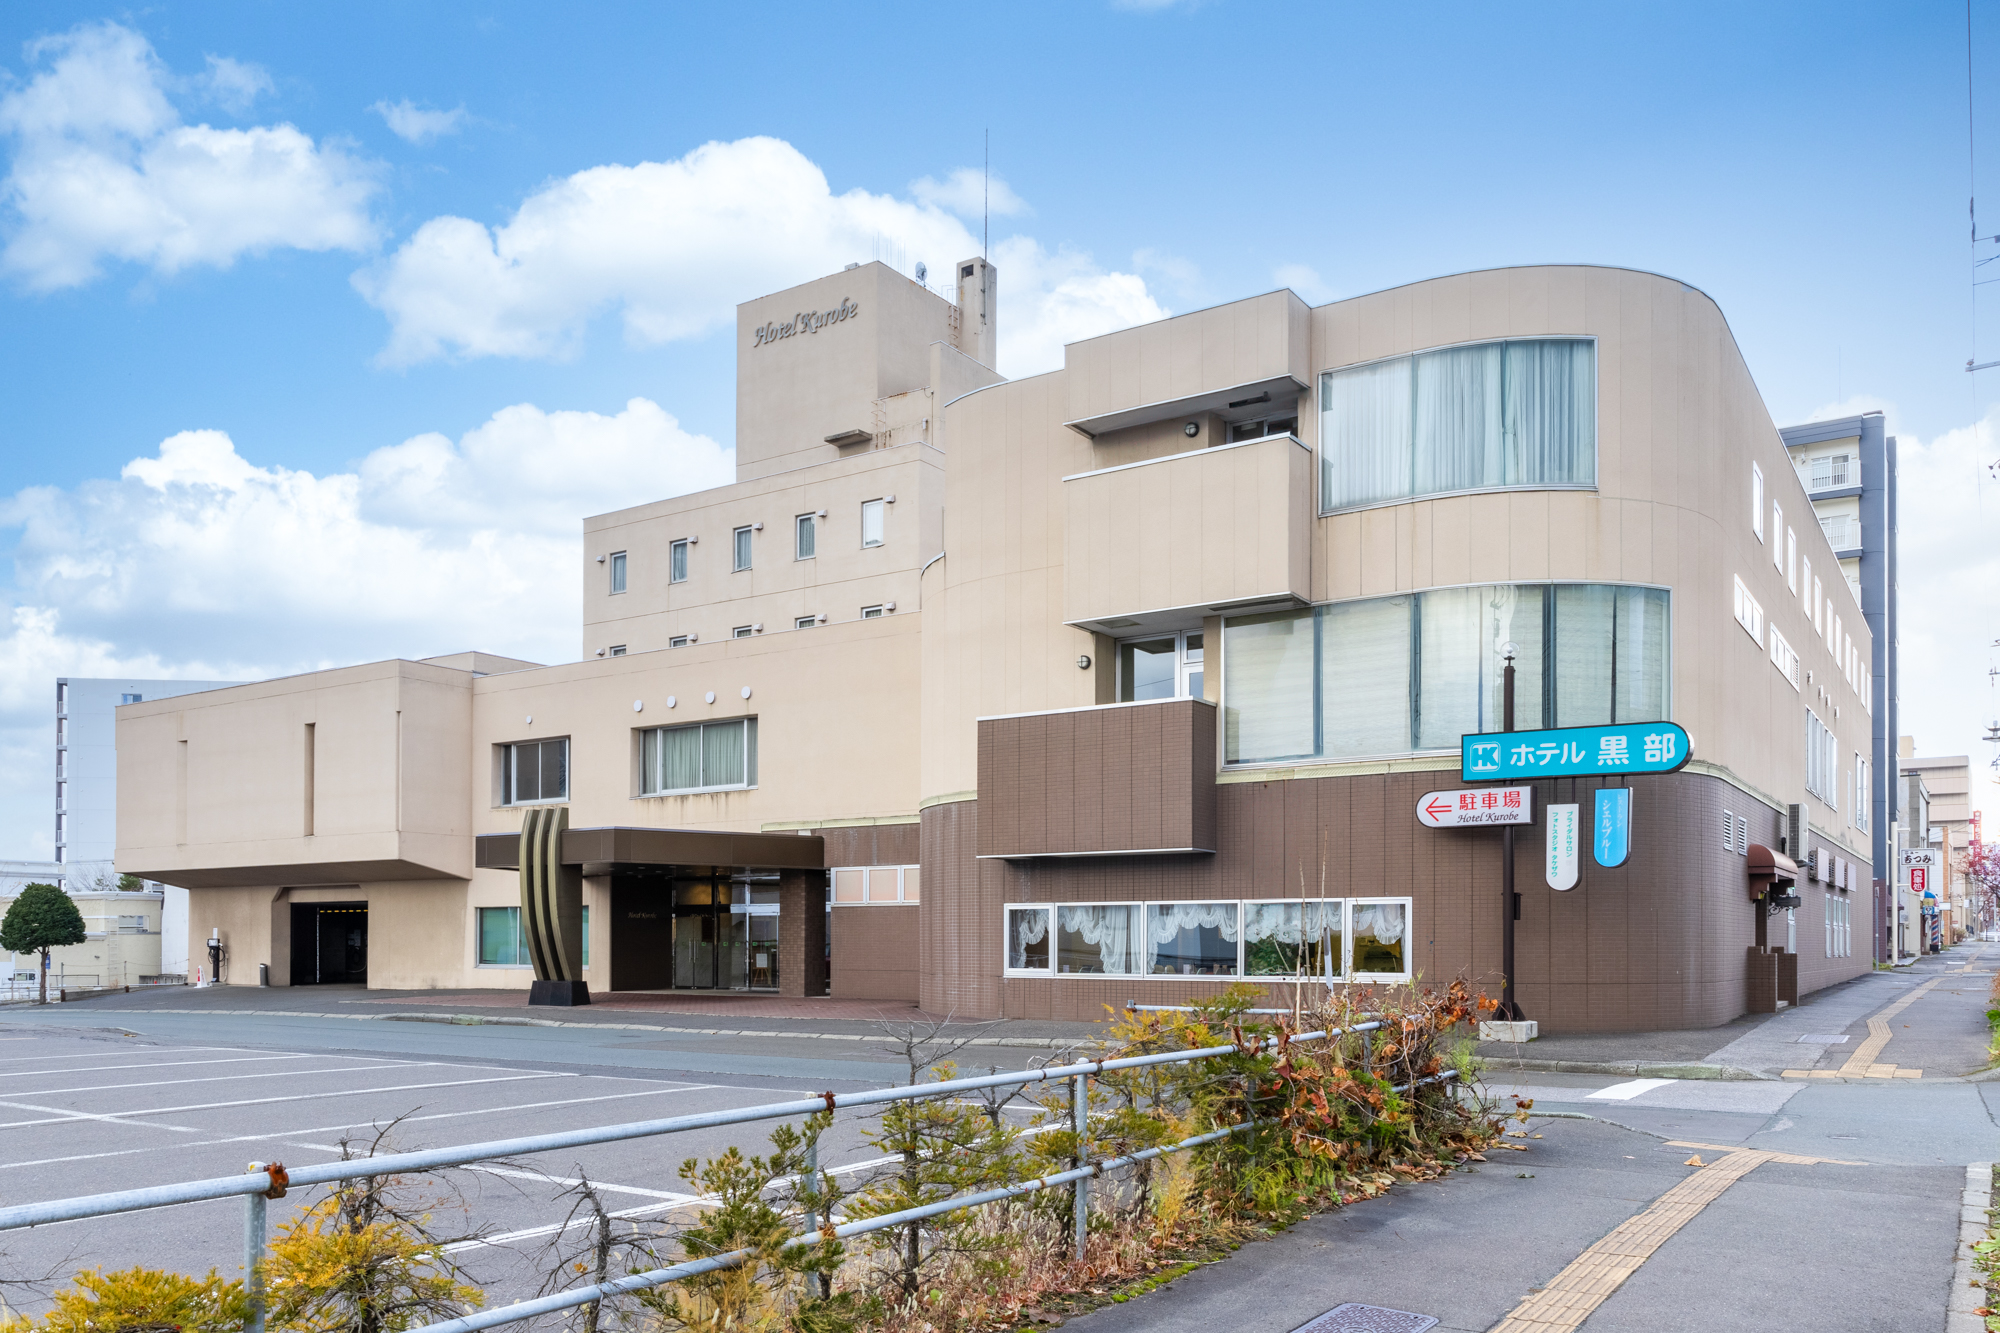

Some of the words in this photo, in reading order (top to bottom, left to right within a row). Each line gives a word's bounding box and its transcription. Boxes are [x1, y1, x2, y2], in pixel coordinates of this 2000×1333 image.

[753, 312, 800, 347] Hotel
[800, 296, 858, 334] Kurobe
[1459, 790, 1521, 811] 駐車場
[1457, 812, 1485, 823] Hotel
[1485, 810, 1519, 823] Kurobe
[1551, 812, 1559, 852] フォトスタジオ
[1566, 811, 1574, 858] ブライダルサロン
[1913, 869, 1923, 891] 食事処
